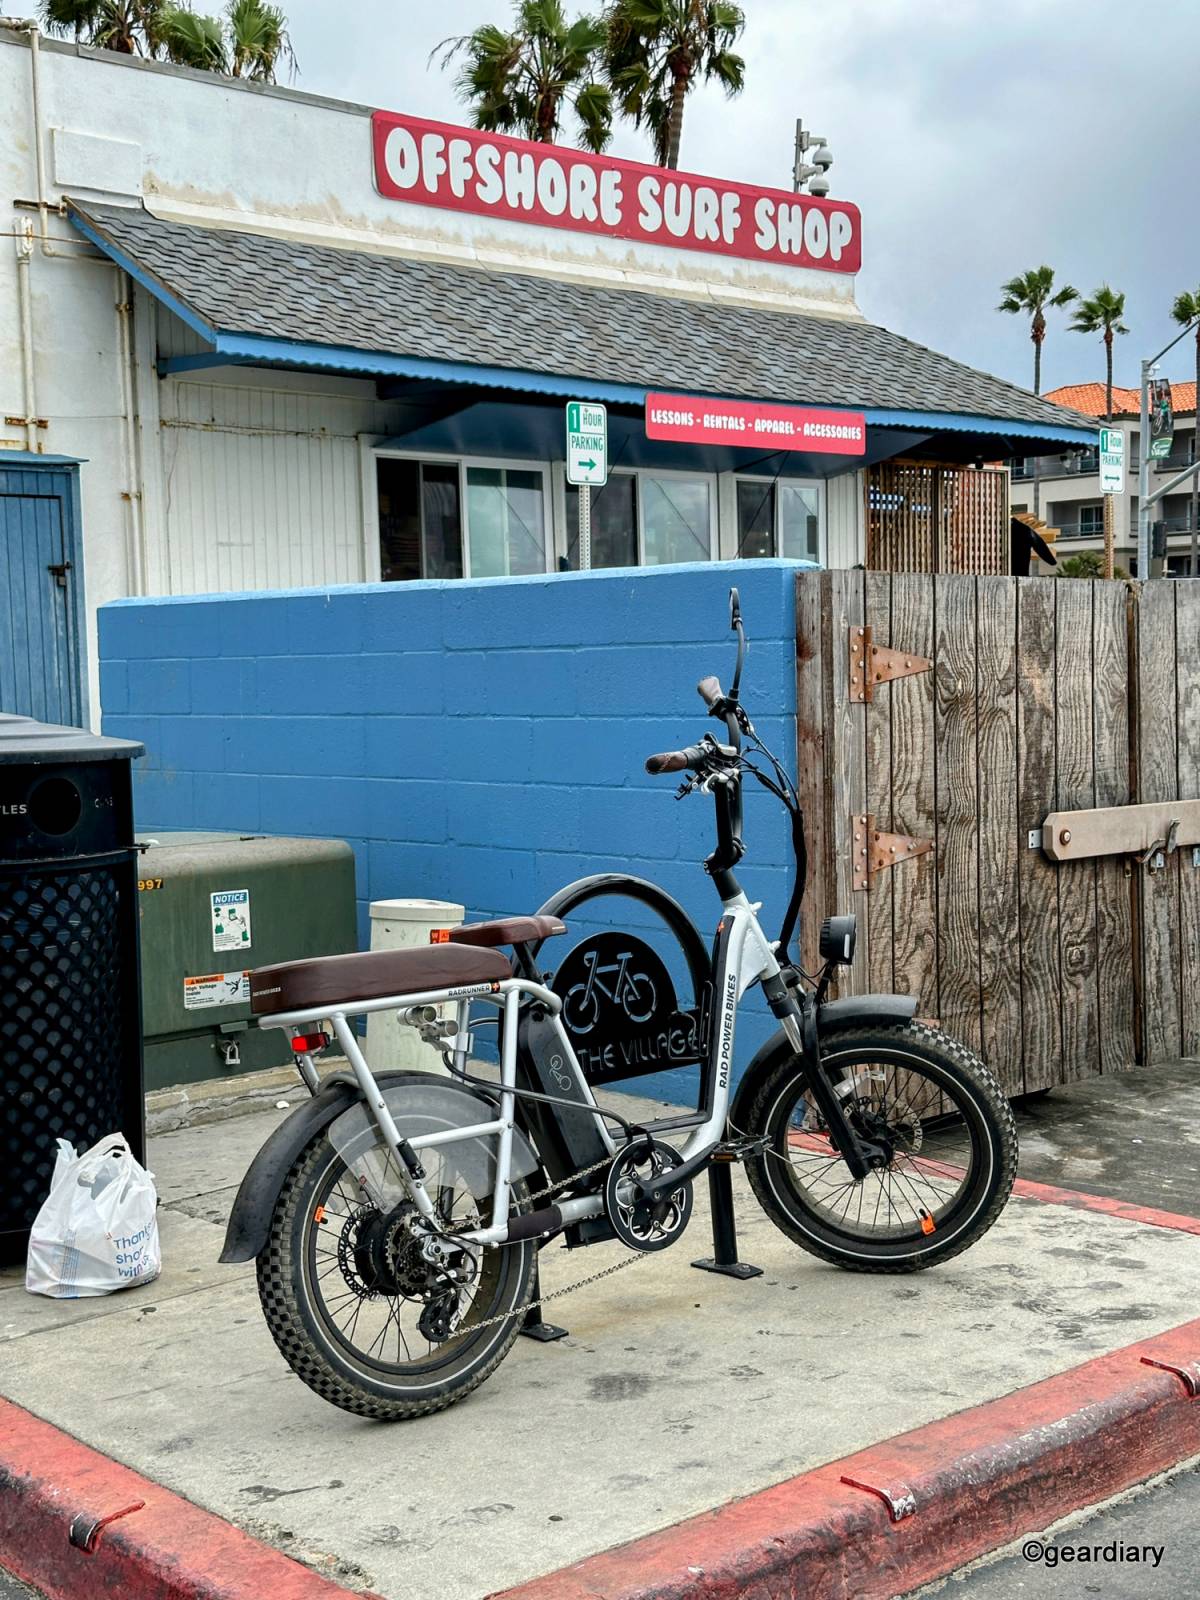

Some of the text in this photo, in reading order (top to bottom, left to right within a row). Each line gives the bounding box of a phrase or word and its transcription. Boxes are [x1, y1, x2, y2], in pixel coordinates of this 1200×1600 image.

[384, 127, 853, 262] OFFSHORE SURF SHOP
[572, 408, 602, 429] 1 HOUR
[651, 409, 694, 426] LESSONS
[703, 414, 745, 431] RENTALS
[754, 418, 795, 435] APPAREL
[803, 422, 862, 441] ACCESSORIES
[571, 435, 604, 451] PARKING
[138, 879, 162, 891] 997
[214, 893, 245, 904] NOTICE
[448, 985, 490, 997] RADRUNNER
[719, 974, 737, 1089] RAD POWER BIKES
[577, 1028, 699, 1073] THE VILLAGE
